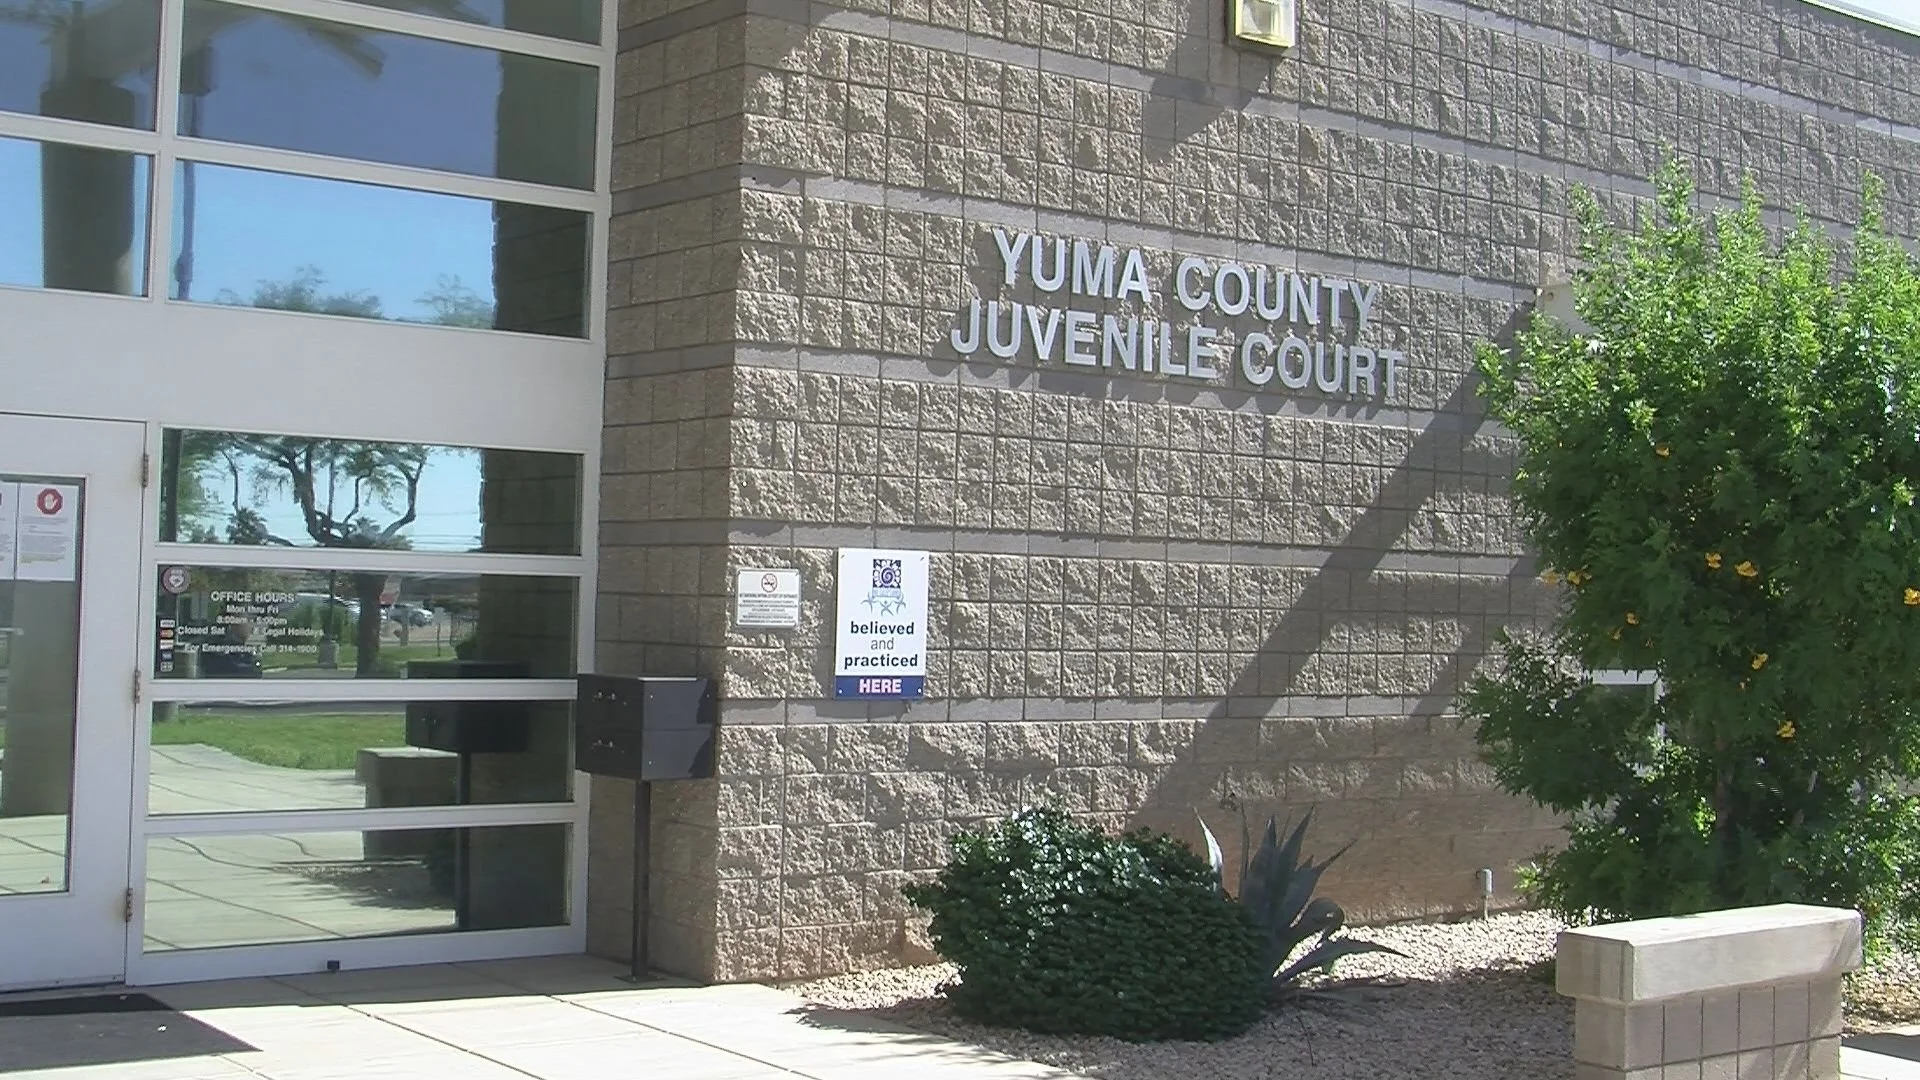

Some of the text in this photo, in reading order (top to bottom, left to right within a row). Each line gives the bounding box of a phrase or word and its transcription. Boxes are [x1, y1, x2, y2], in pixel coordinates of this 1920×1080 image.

[993, 230, 1378, 332] YUMA COUNTY
[951, 299, 1404, 398] JUVENILE COURT
[211, 591, 295, 602] OFFICE HOURS
[226, 604, 246, 613] Mon
[267, 604, 279, 614] Fri
[177, 625, 209, 635] Closed
[850, 621, 915, 635] believed
[870, 637, 895, 650] and
[844, 654, 918, 670] practiced
[859, 679, 902, 694] HERE
